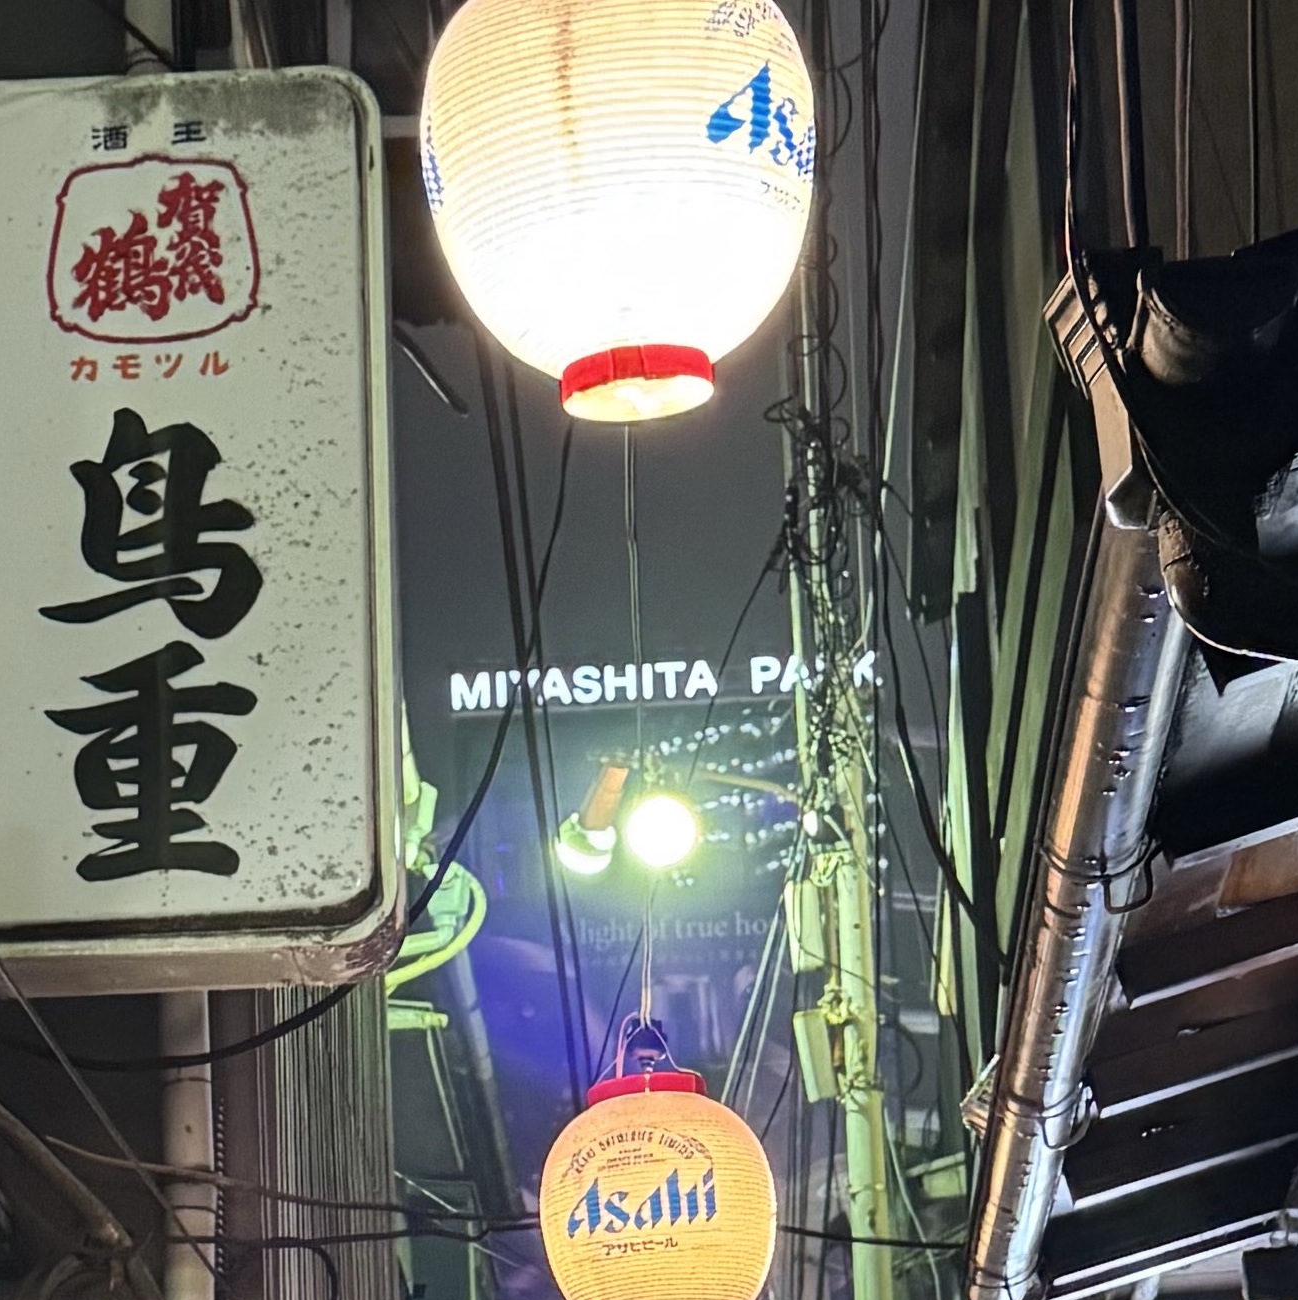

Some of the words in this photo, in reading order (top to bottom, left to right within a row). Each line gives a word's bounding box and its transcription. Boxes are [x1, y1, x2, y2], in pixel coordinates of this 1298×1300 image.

[70, 351, 229, 382] カモツル
[39, 408, 263, 882] 鳥重
[750, 650, 876, 694] PAK
[675, 916, 728, 940] true
[567, 1167, 717, 1239] Asahi
[601, 1237, 679, 1256] アサヒビール
